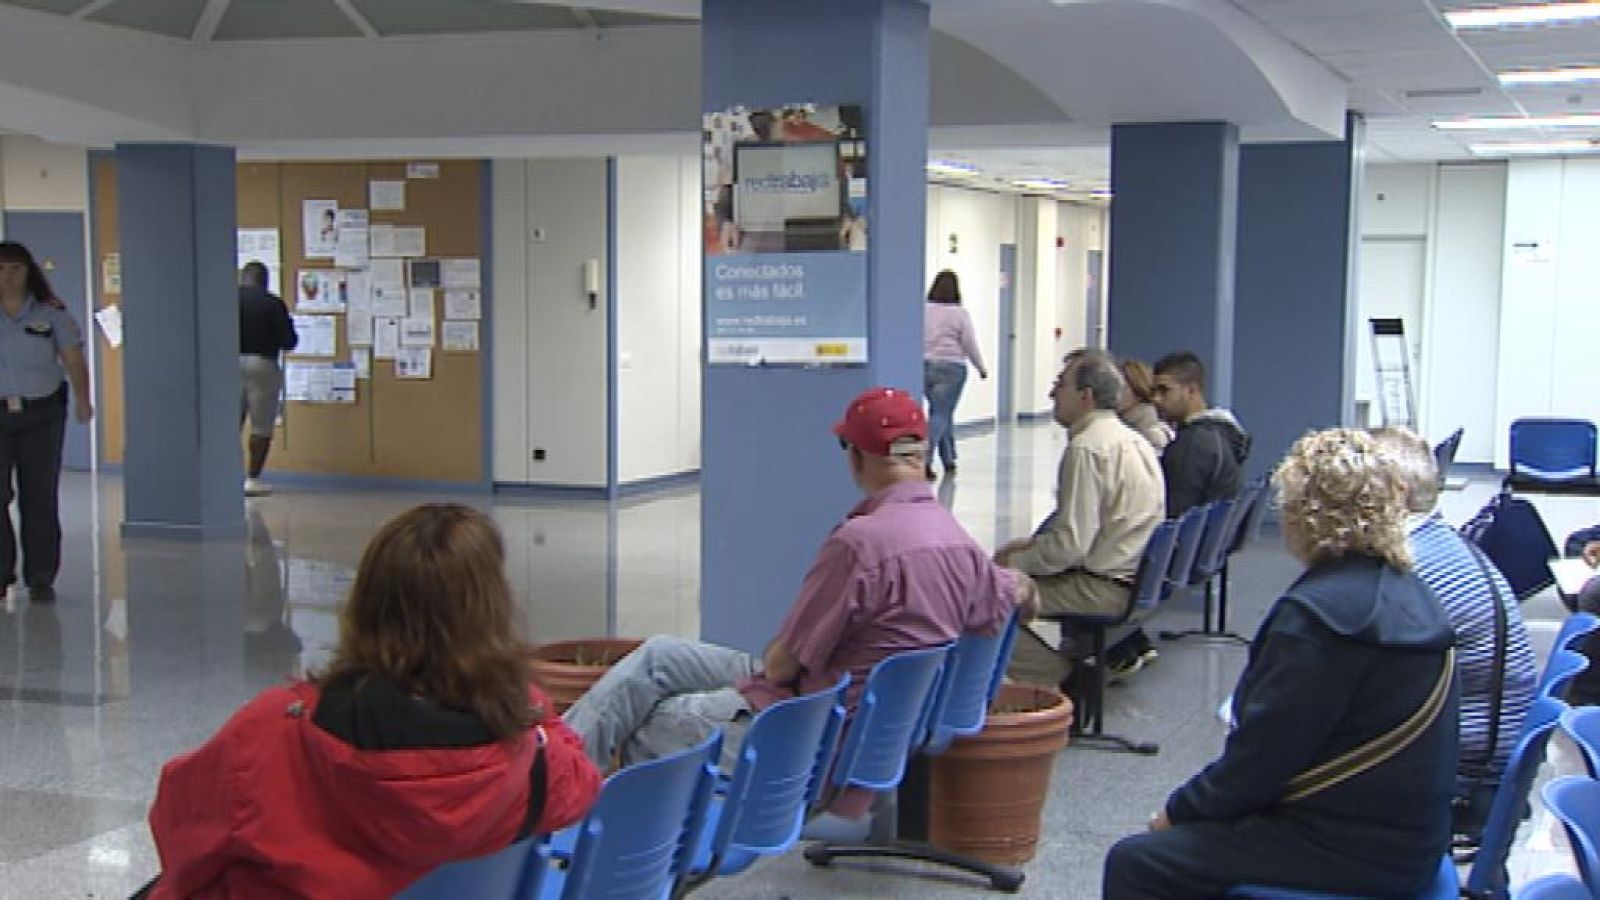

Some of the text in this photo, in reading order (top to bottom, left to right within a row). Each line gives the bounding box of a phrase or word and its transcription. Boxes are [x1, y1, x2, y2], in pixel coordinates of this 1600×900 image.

[716, 263, 804, 279] Conectados
[716, 286, 734, 300] es
[737, 283, 769, 300] más
